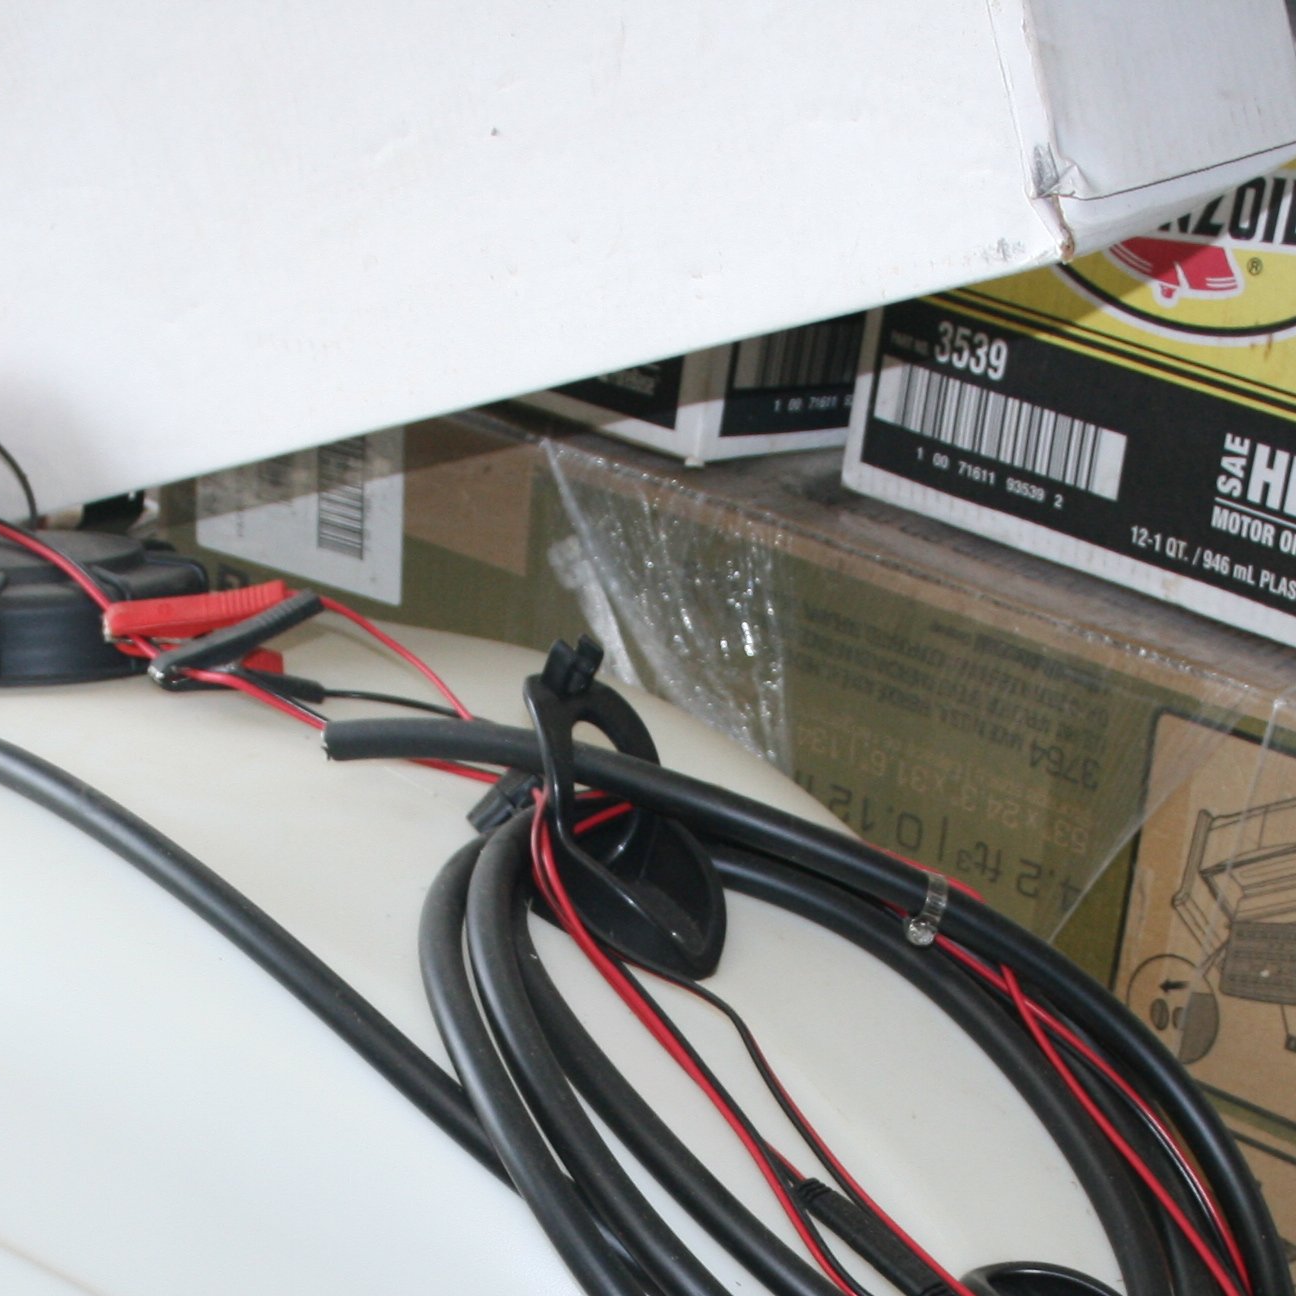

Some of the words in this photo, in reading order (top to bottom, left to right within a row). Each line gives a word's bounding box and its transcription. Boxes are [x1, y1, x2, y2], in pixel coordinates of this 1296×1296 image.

[934, 320, 1009, 381] 3539
[916, 447, 923, 460] 1
[958, 461, 996, 486] 71611
[1006, 477, 1046, 503] 93539
[1054, 494, 1063, 509] 2
[1216, 432, 1251, 498] SAE
[1130, 525, 1162, 552] 12-1
[1165, 536, 1189, 562] QT.
[1203, 549, 1230, 576] 946
[1232, 564, 1255, 585] mL
[1211, 505, 1274, 548] MOTOR
